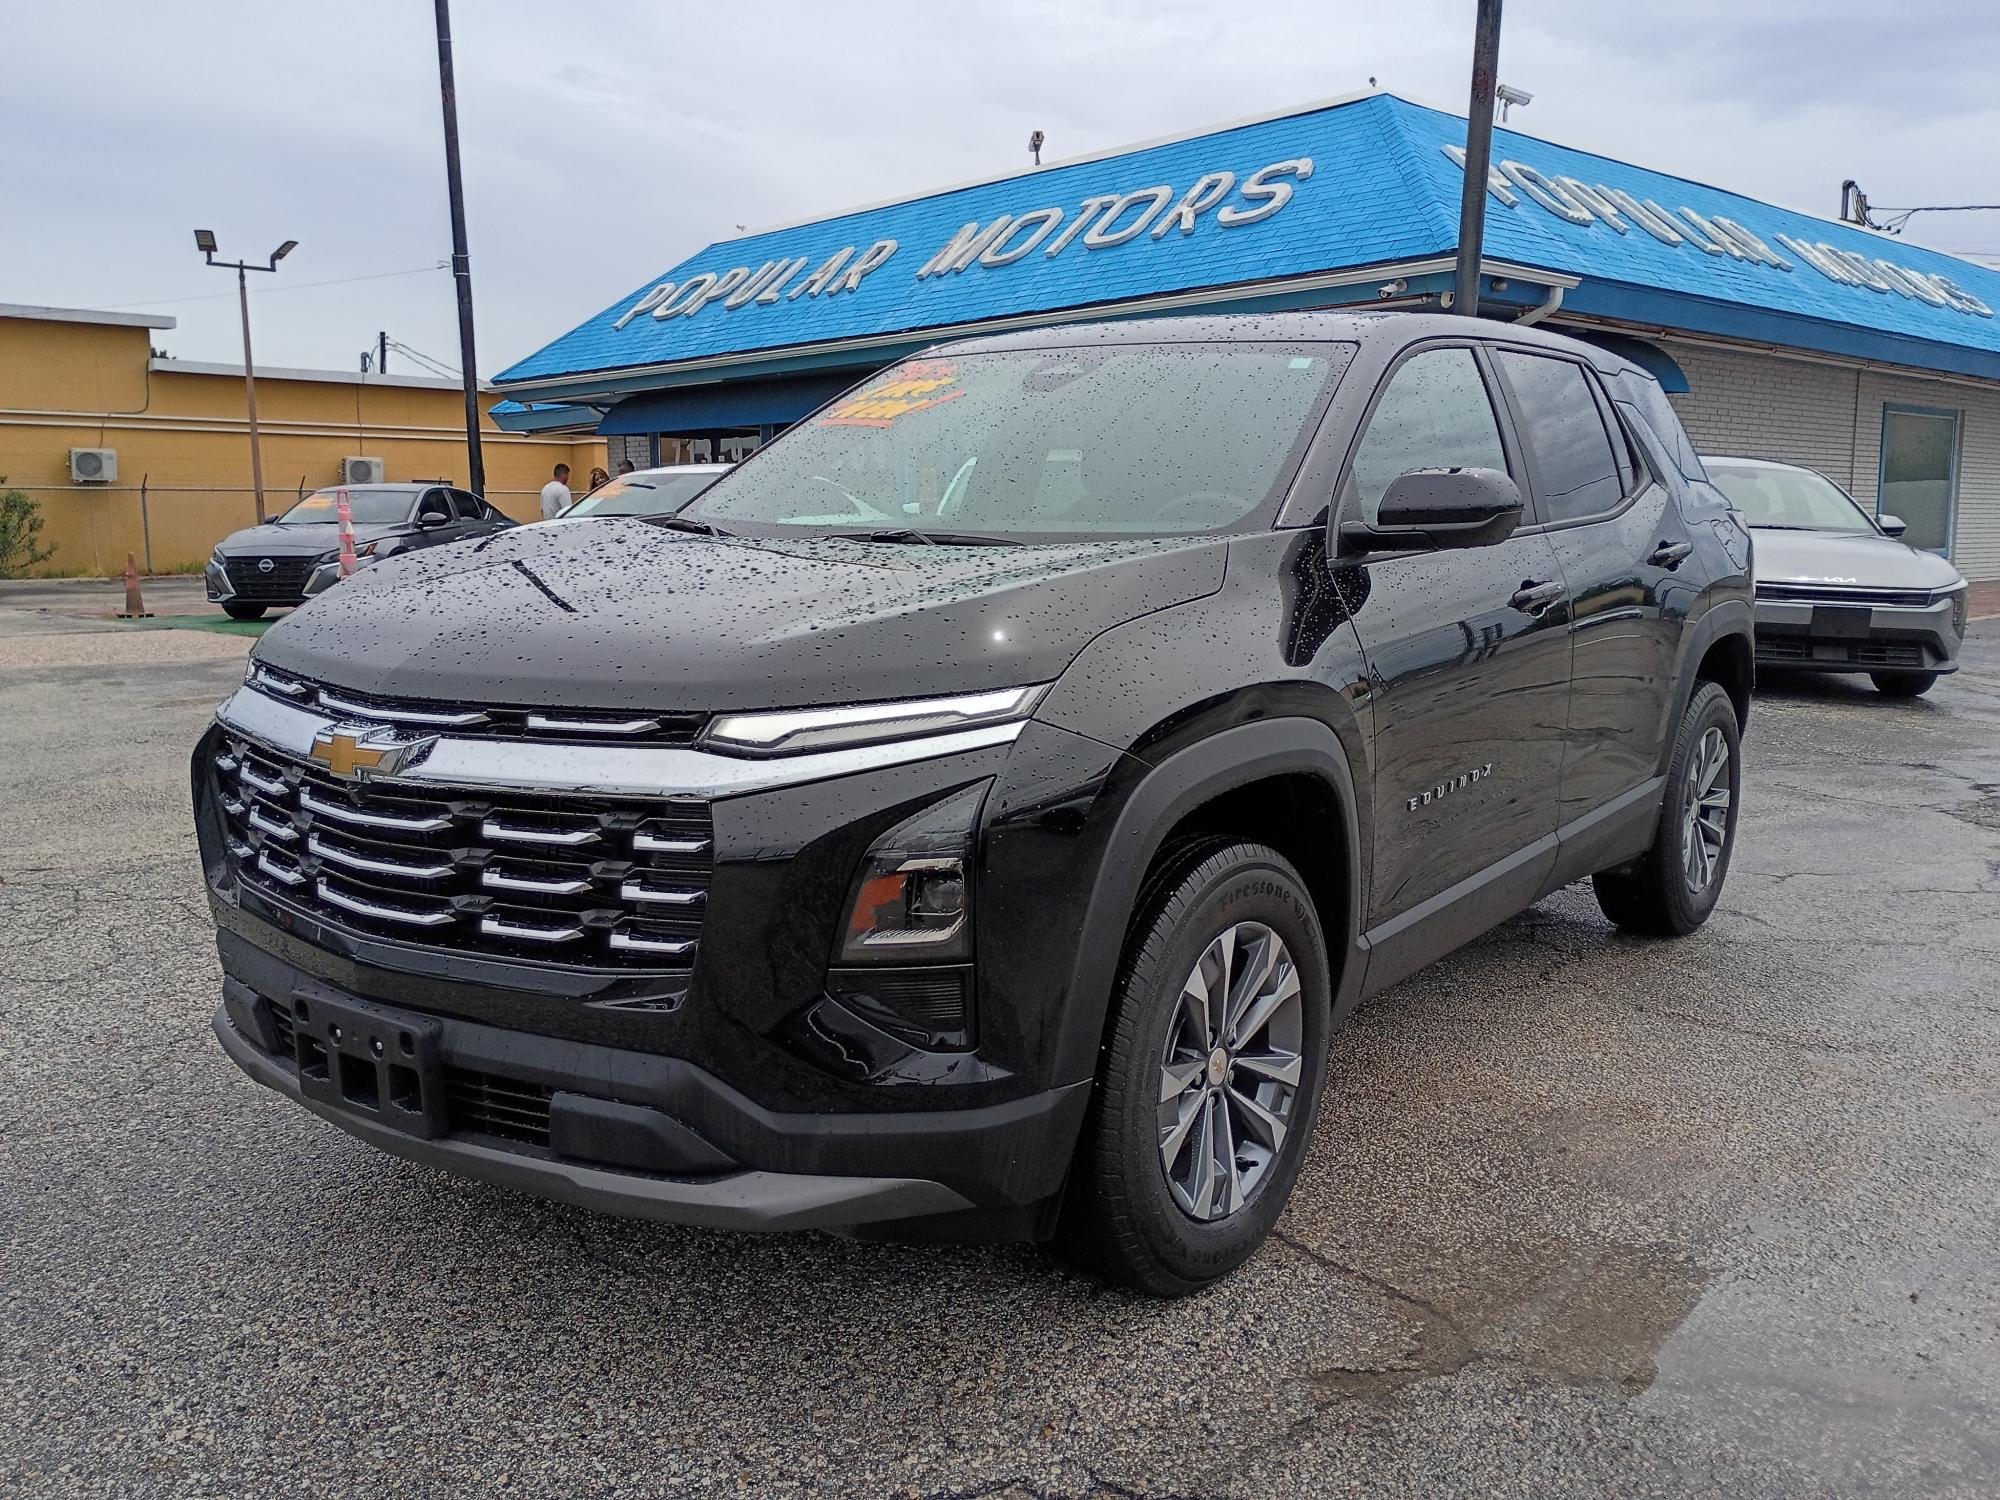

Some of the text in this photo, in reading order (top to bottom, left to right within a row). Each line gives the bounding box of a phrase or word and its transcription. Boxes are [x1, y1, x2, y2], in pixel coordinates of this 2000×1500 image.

[612, 158, 1315, 330] POPULAR MOTORS
[1440, 144, 1795, 272] POPULAR
[1407, 763, 1492, 812] EQUINOX
